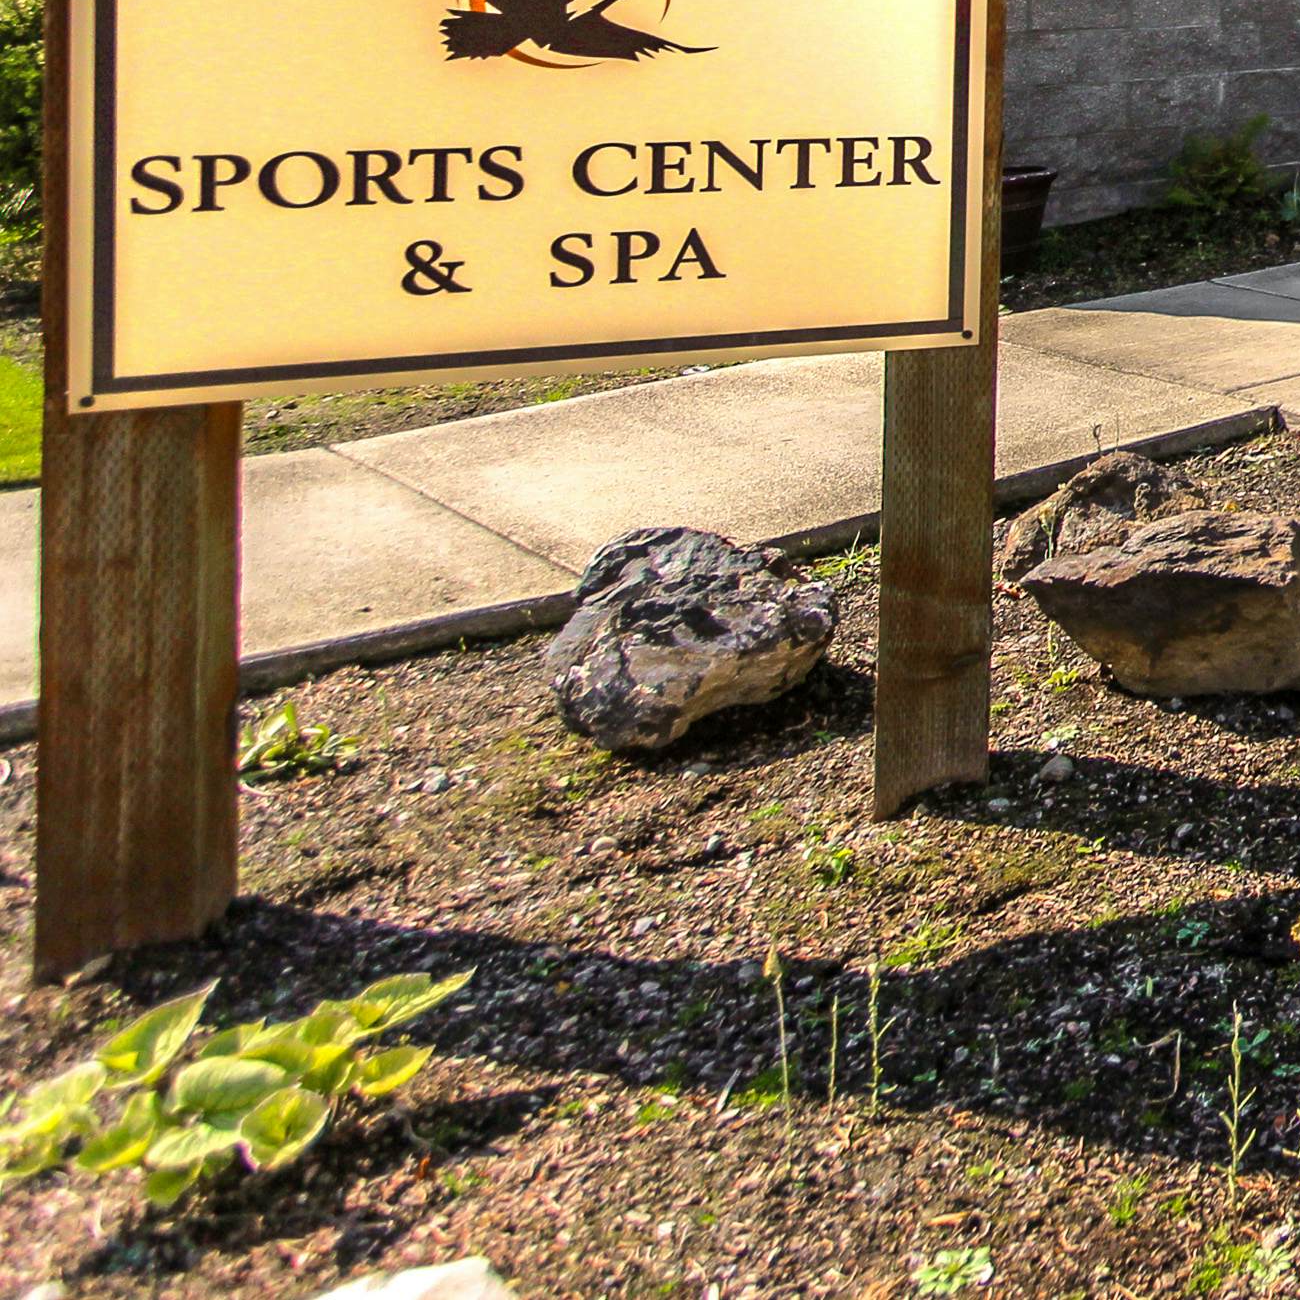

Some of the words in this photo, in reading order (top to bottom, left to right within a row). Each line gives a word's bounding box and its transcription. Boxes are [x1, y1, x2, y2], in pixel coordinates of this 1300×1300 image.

[130, 145, 525, 215] SPORTS
[572, 136, 941, 197] CENTER
[400, 240, 473, 297] &
[548, 227, 727, 288] SPA
